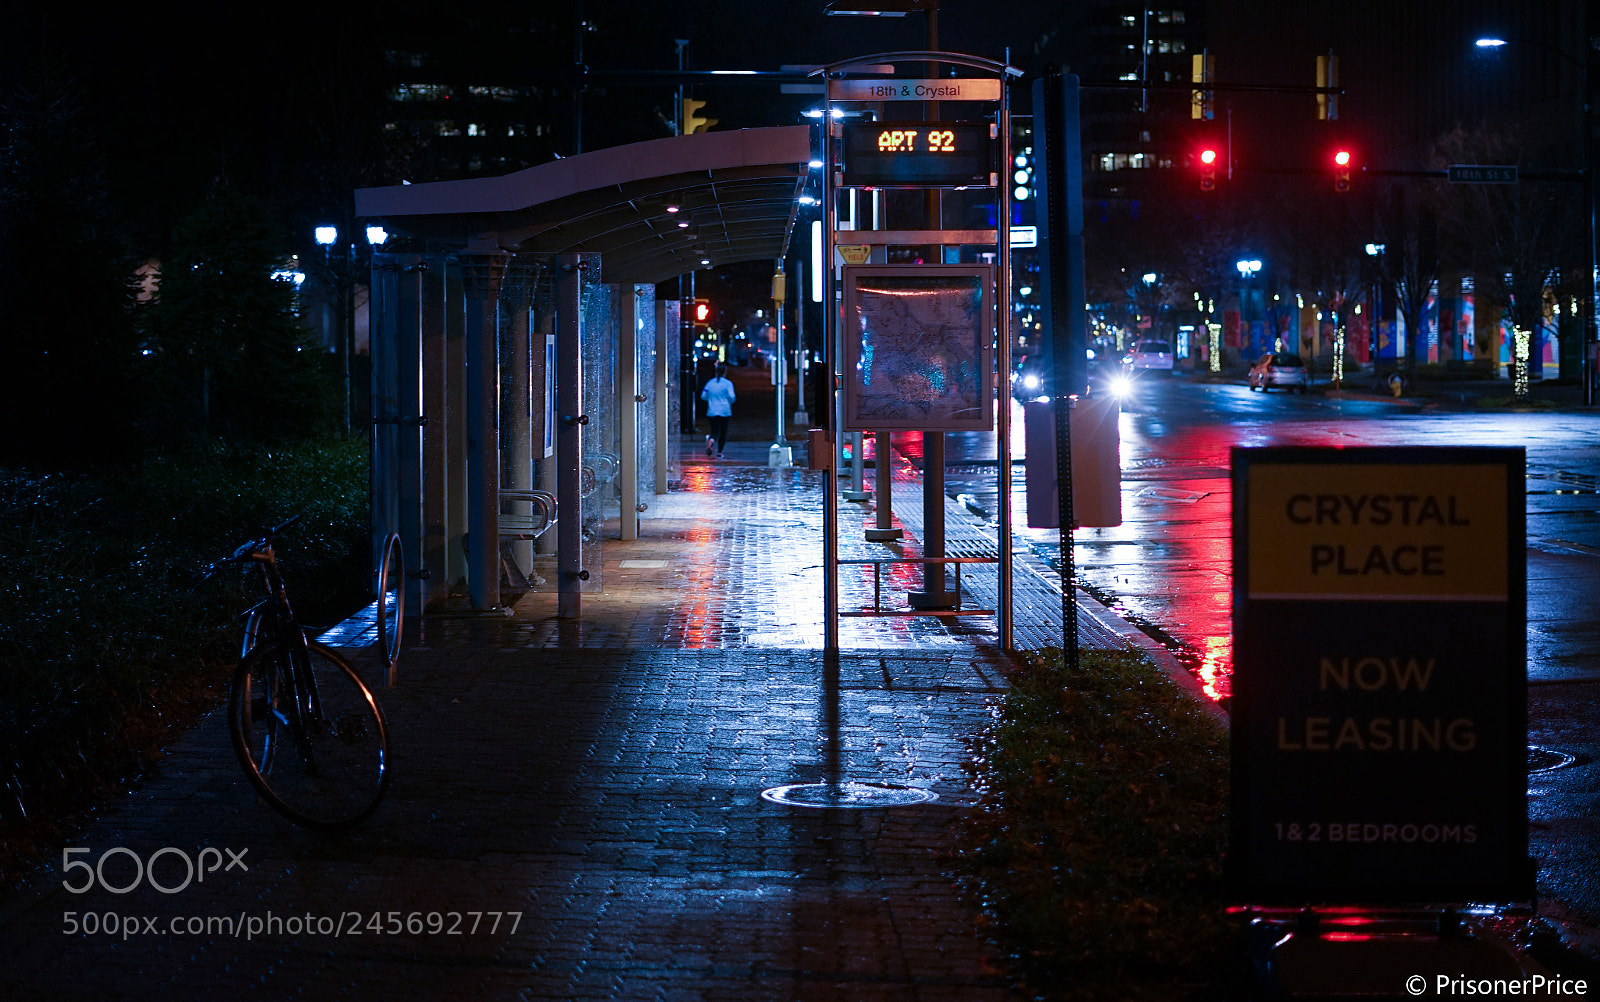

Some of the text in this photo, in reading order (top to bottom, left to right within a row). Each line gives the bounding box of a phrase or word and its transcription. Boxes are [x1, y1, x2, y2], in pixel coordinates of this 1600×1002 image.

[869, 85, 961, 98] 18th & Crystal
[877, 129, 956, 153] ART 92
[1456, 169, 1510, 180] 18th St S
[1286, 494, 1470, 526] CRYSTAL
[1311, 545, 1445, 576] PLACE
[1320, 657, 1436, 691] NOW
[1278, 717, 1475, 752] LEASING
[1328, 822, 1477, 843] BEDROOMS
